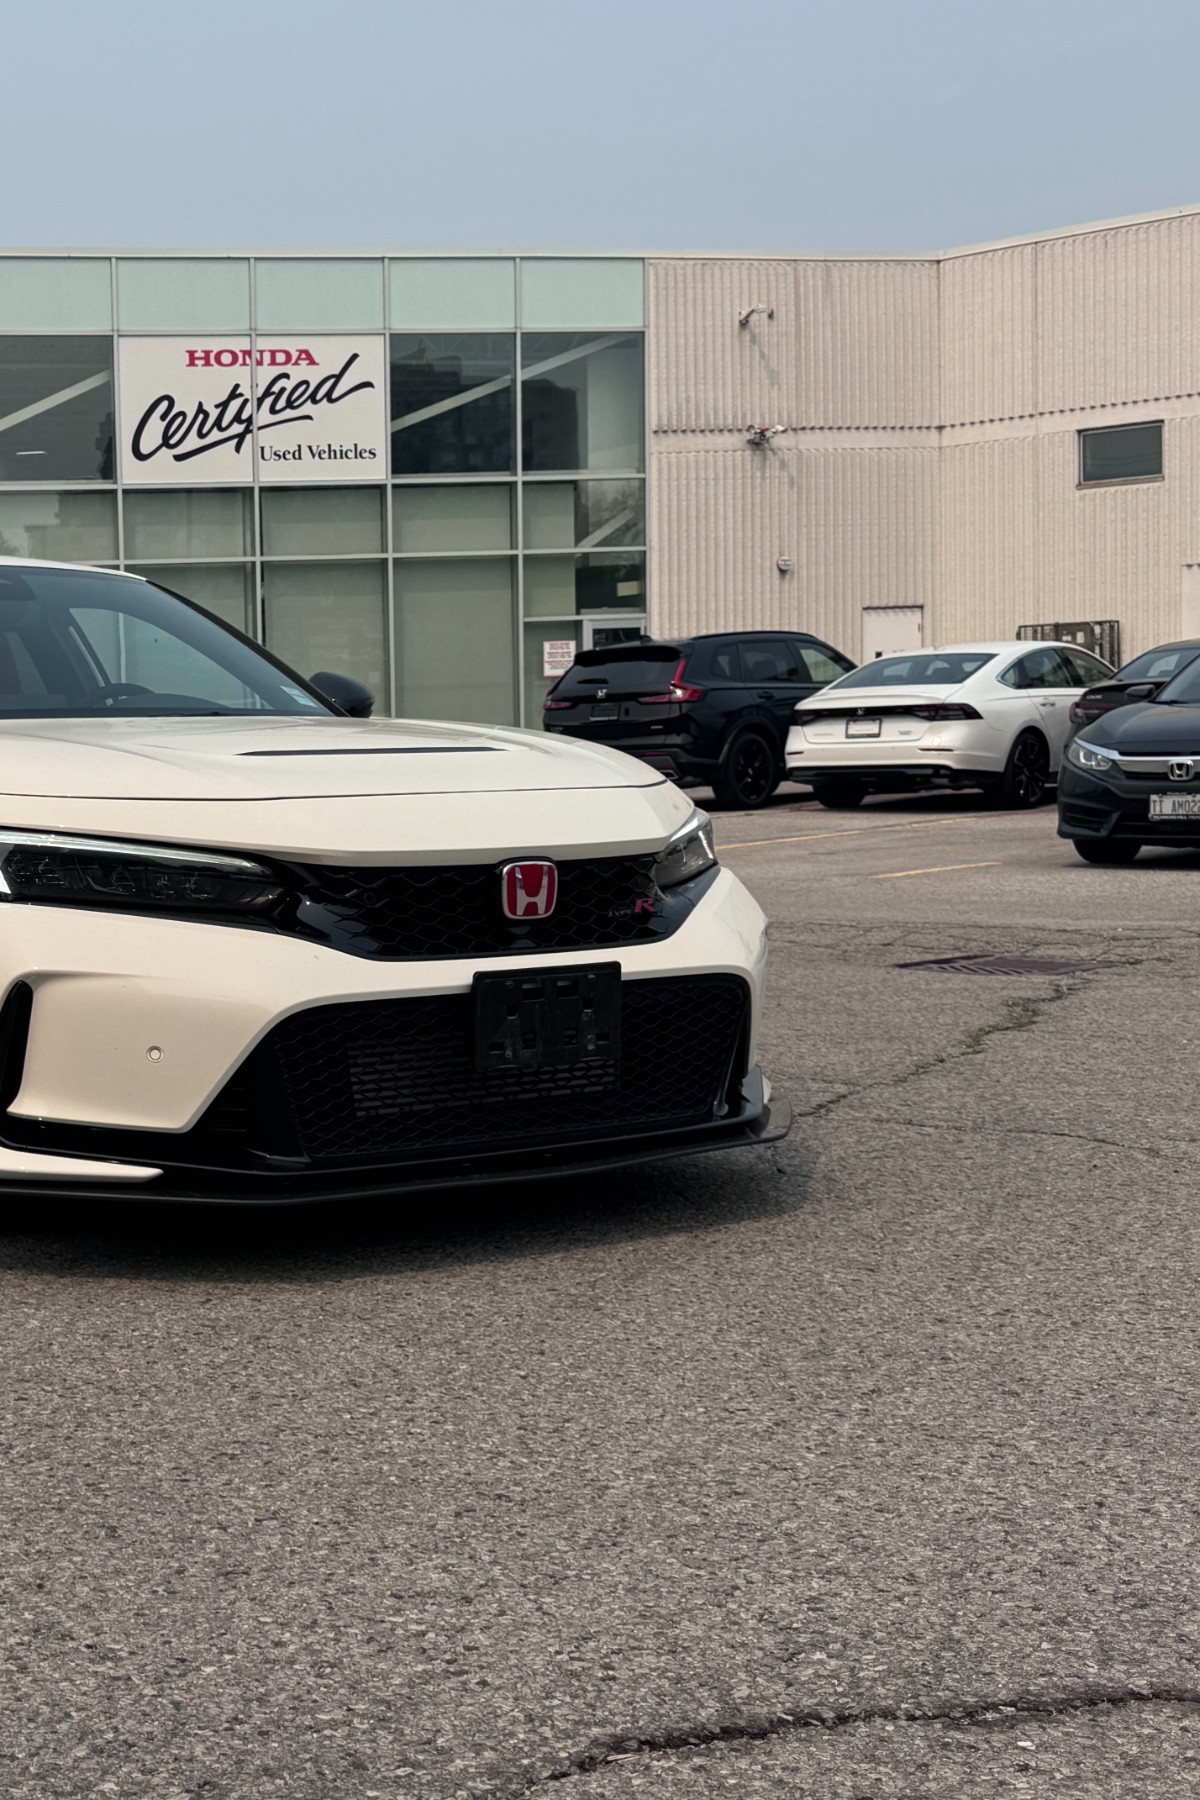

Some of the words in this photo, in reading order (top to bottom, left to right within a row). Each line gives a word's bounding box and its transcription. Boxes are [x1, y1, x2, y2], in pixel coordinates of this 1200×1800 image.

[185, 349, 320, 367] HONDA
[131, 352, 375, 462] Certified
[260, 444, 303, 461] Used
[307, 443, 377, 460] Vehicles
